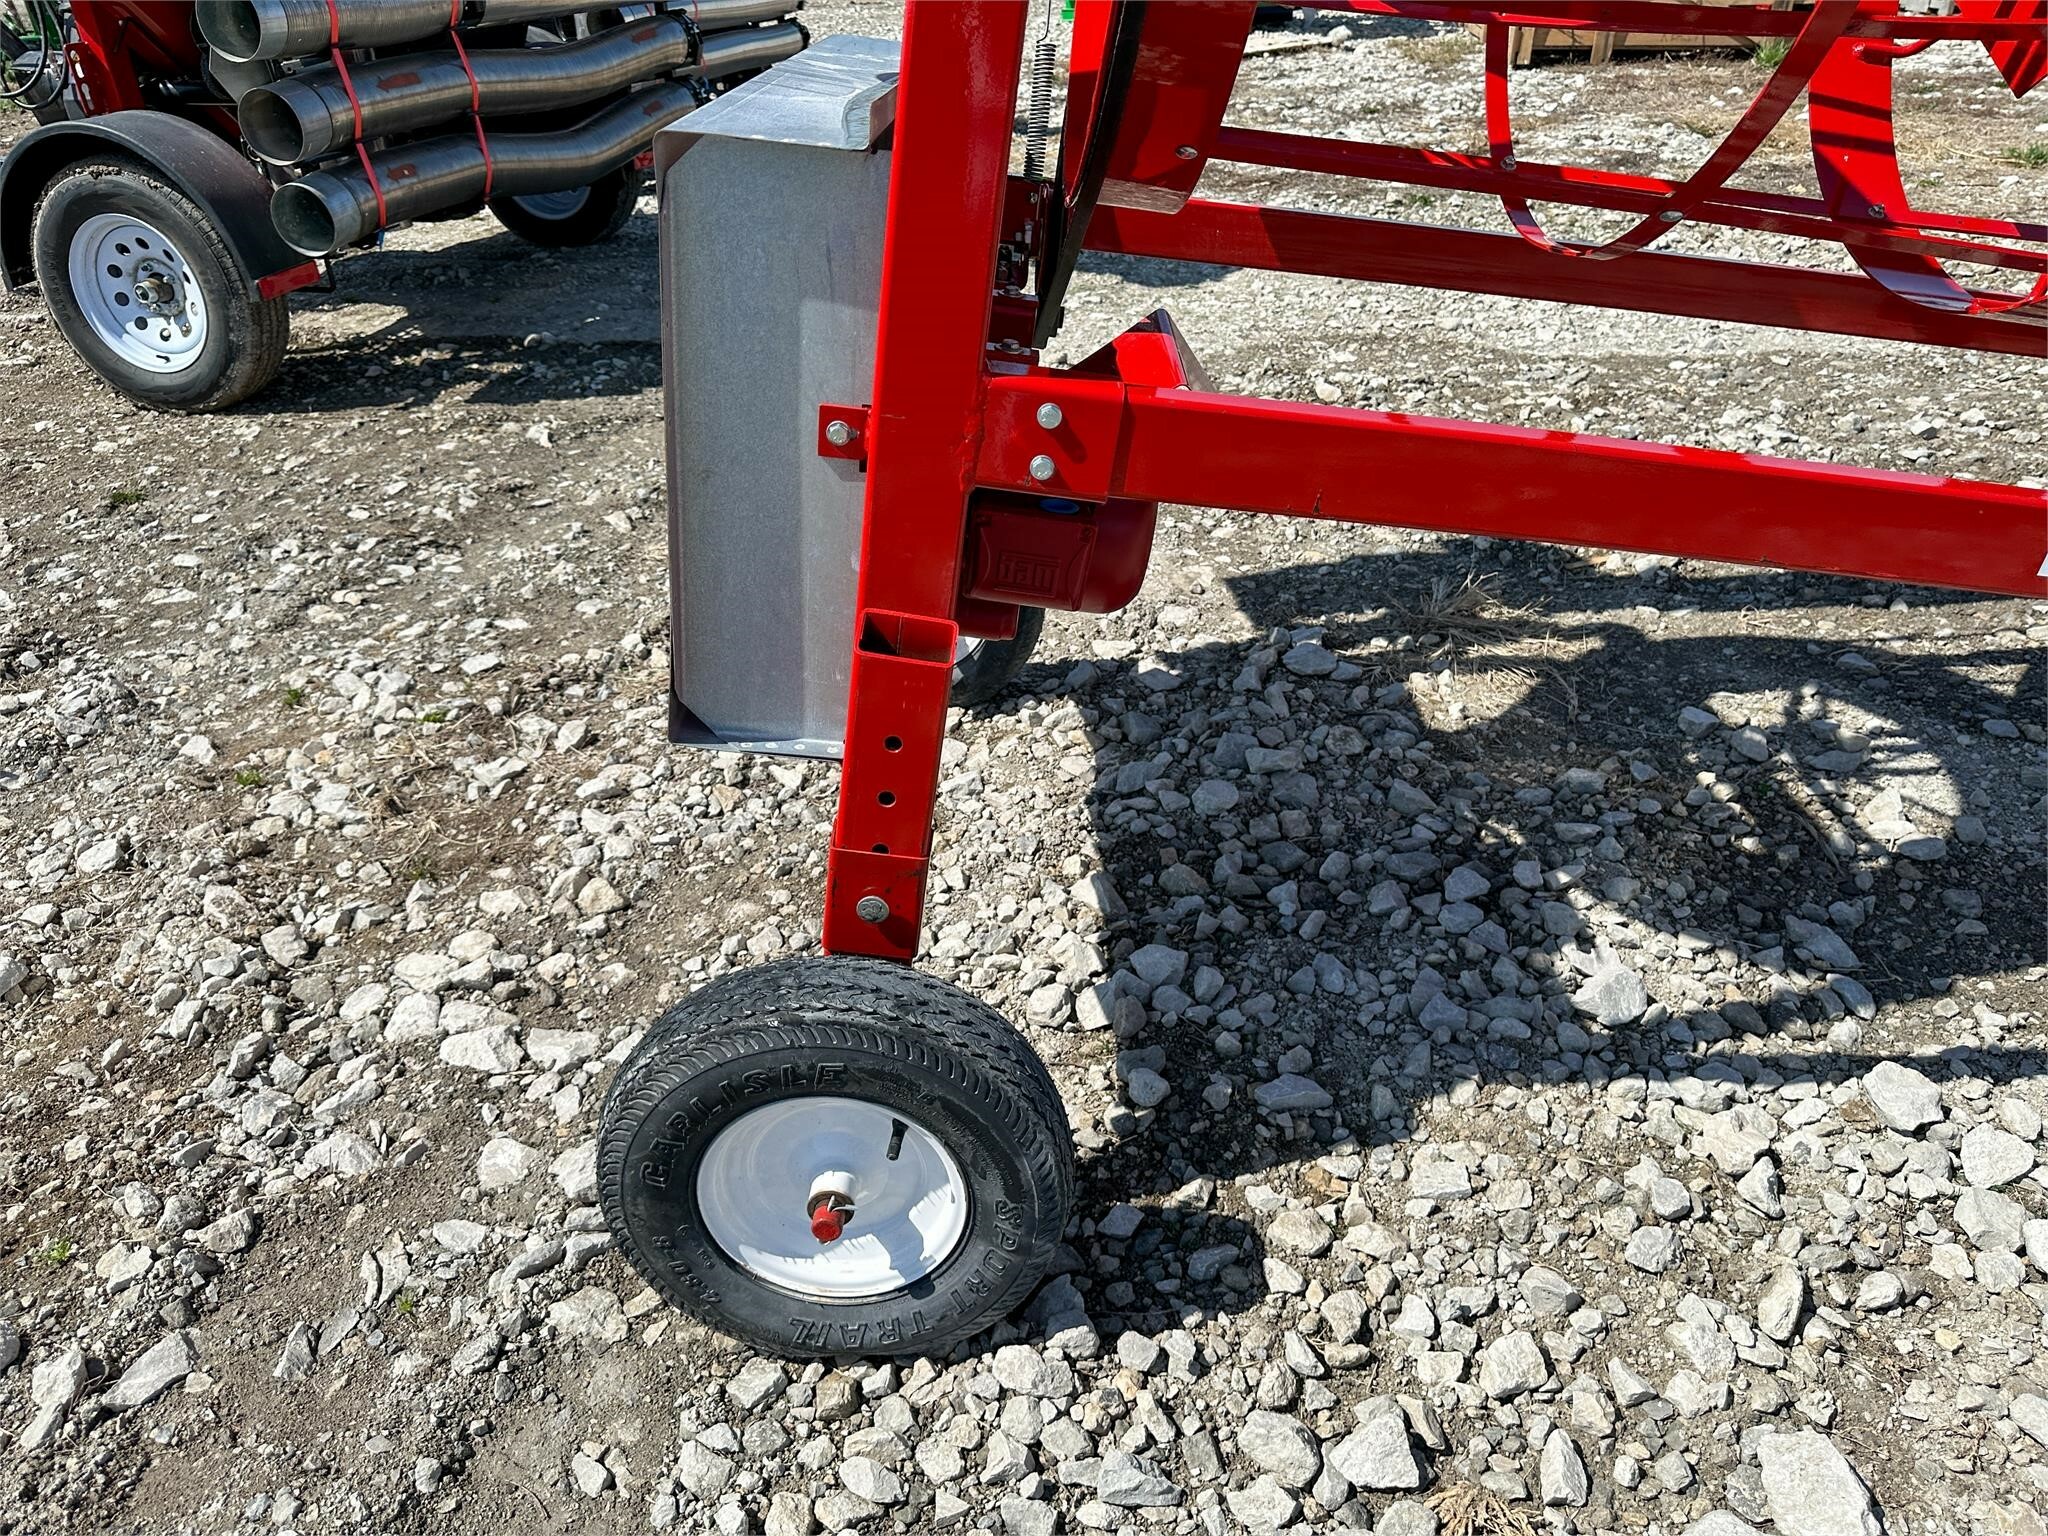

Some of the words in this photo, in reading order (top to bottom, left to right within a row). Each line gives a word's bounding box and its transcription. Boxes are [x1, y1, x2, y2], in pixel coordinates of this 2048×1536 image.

[639, 1062, 847, 1189] CARLISLE
[951, 1200, 1024, 1316] SPORT
[789, 1309, 935, 1350] TRAIL
